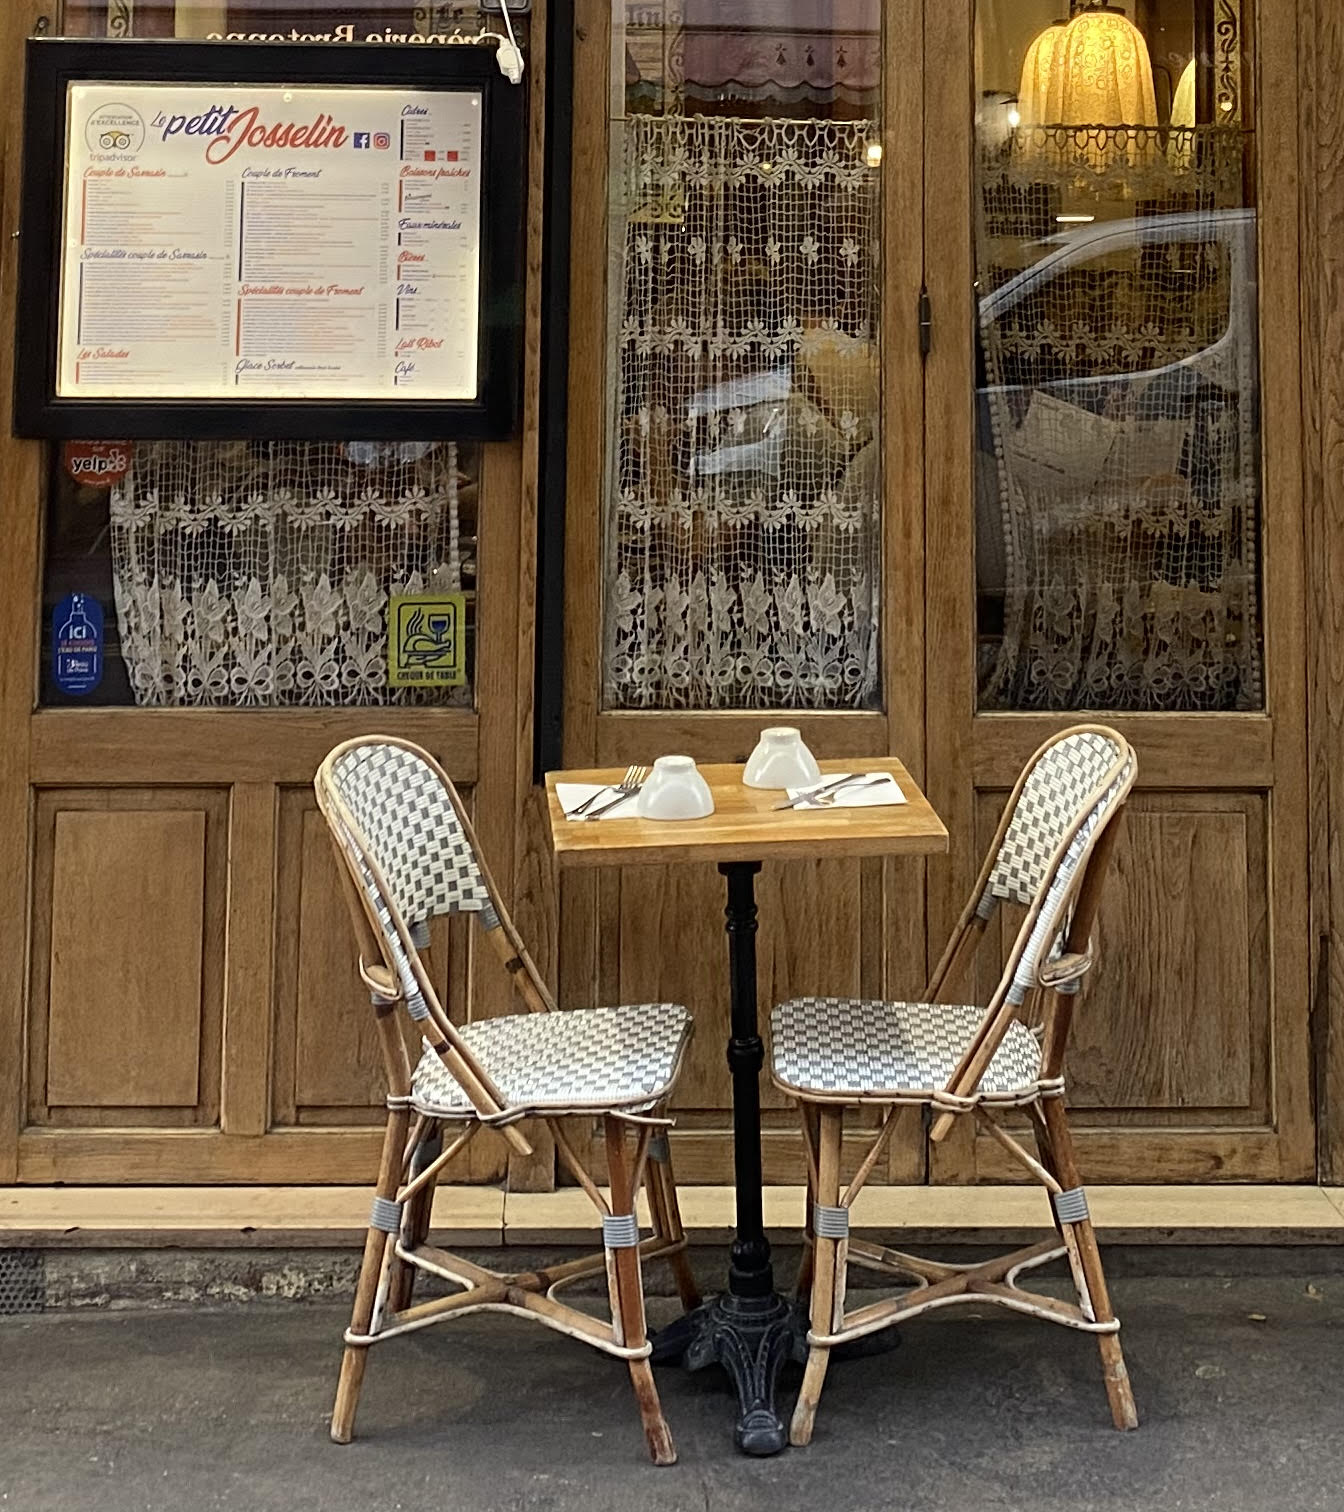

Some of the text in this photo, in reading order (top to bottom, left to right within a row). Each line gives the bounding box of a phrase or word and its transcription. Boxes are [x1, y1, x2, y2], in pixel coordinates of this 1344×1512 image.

[162, 105, 239, 142] petit
[205, 106, 349, 165] Josselin
[72, 455, 109, 475] yelp
